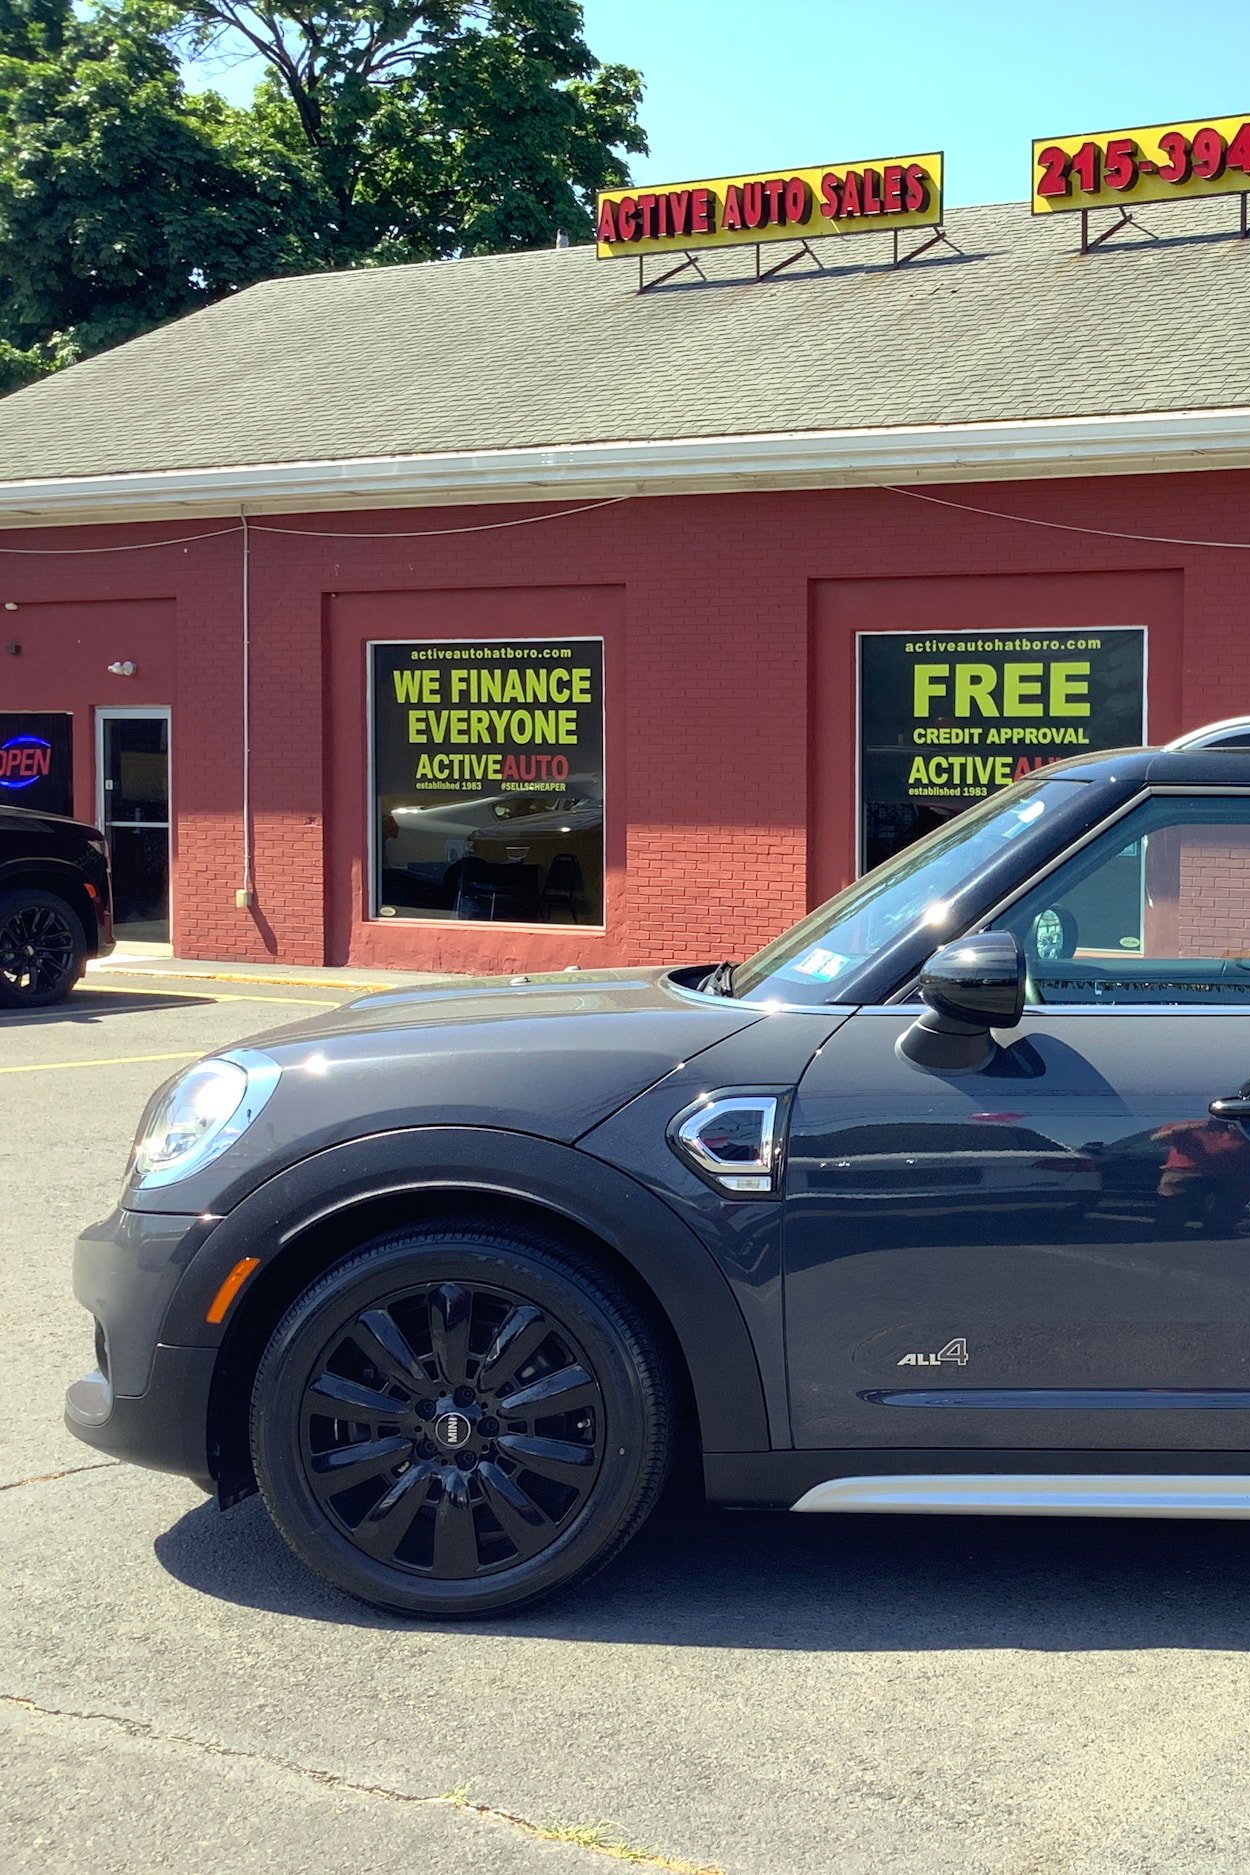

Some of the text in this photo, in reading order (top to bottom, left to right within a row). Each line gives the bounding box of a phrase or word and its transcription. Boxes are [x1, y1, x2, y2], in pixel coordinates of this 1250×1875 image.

[599, 164, 928, 242] ACTIVE AUTO SALES
[411, 648, 571, 660] activeautohatboro.com
[906, 639, 1101, 652] activeautohatboro.com
[393, 668, 591, 703] WE FINANCE
[913, 662, 1090, 717] FREE
[409, 710, 577, 744] EVERYONE
[913, 728, 1089, 744] CREDIT APPROVAL
[416, 781, 482, 790] established 1983
[909, 786, 987, 796] established 1983
[897, 1338, 968, 1365] ALL4
[447, 1417, 458, 1443] MINI
